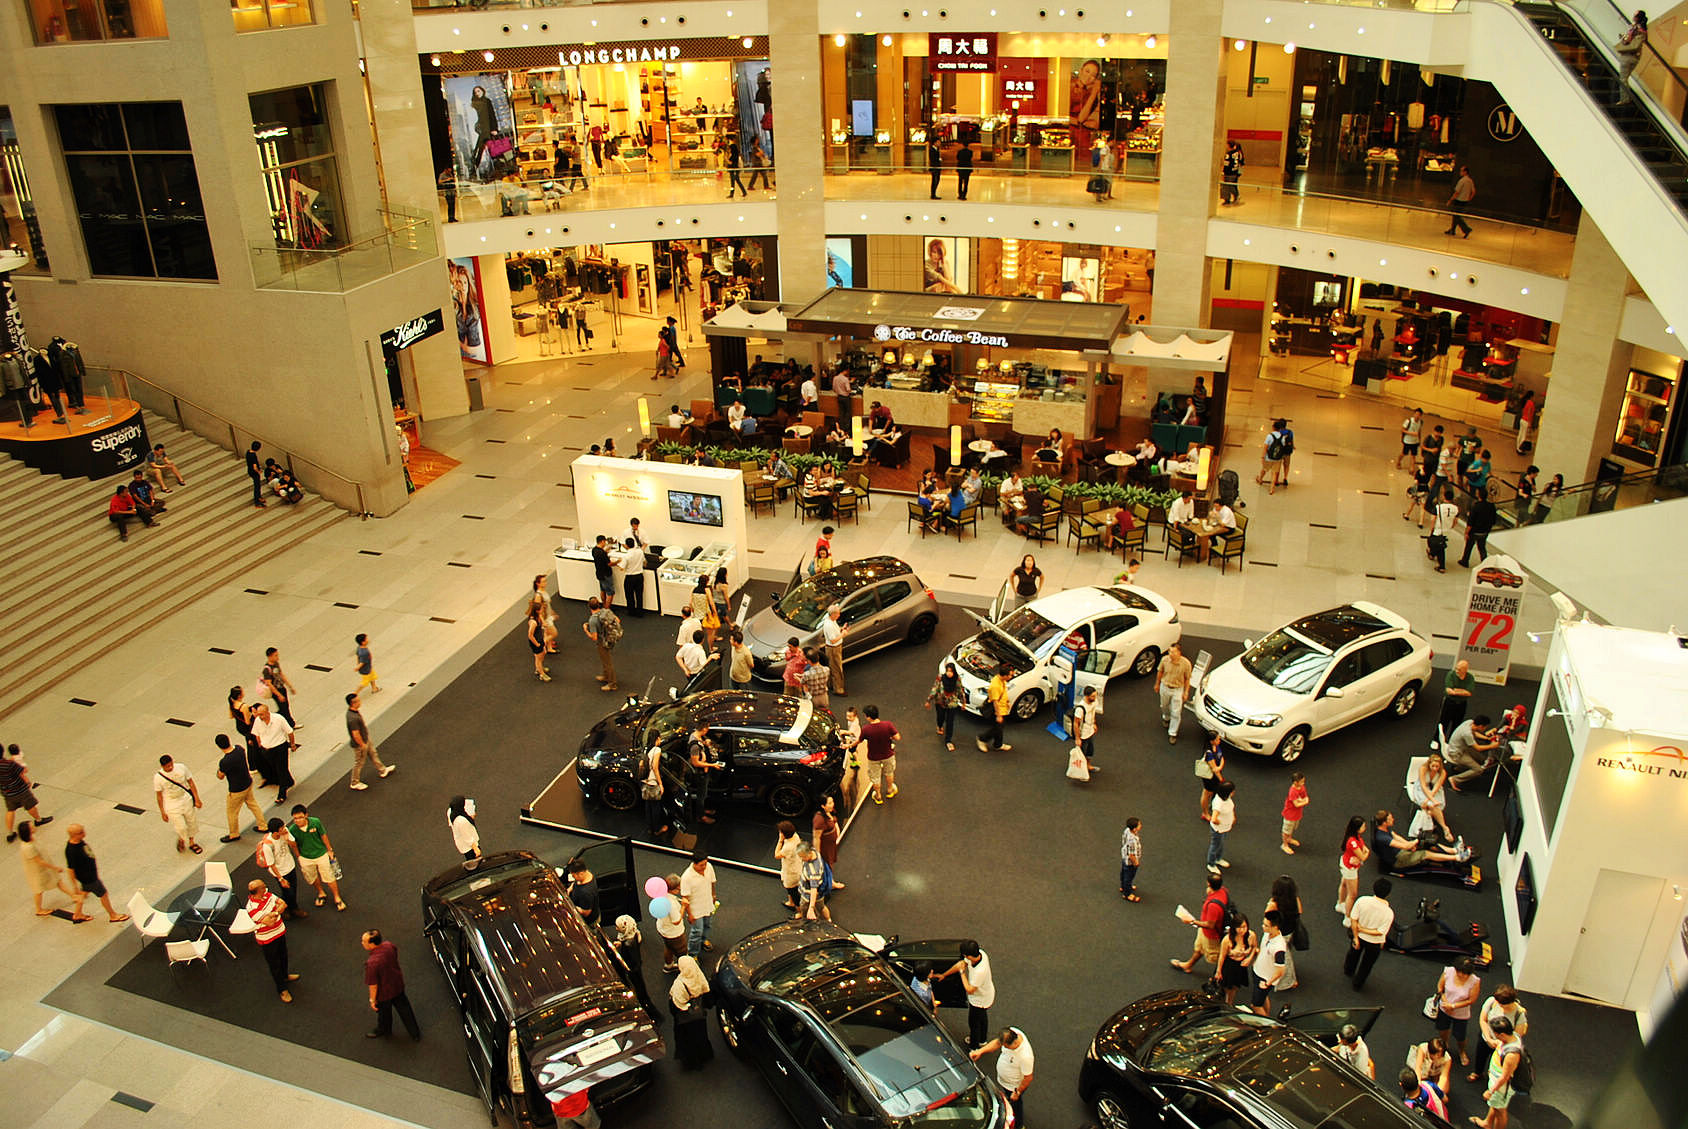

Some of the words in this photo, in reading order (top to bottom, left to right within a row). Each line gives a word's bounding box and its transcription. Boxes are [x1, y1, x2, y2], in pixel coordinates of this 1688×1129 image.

[558, 46, 681, 66] LONGCHAMP
[937, 38, 988, 55] 周大福
[1495, 111, 1516, 134] M
[393, 317, 428, 347] Kiehl's
[893, 326, 916, 341] The
[921, 328, 963, 343] Coffee
[966, 331, 1009, 348] Bean
[1470, 602, 1497, 613] HOME
[1498, 605, 1518, 616] FOR
[1471, 593, 1501, 605] DRIVE
[1503, 597, 1519, 608] ME
[1466, 611, 1516, 651] 72
[1465, 645, 1479, 653] PER
[1597, 757, 1665, 776] RENAULT
